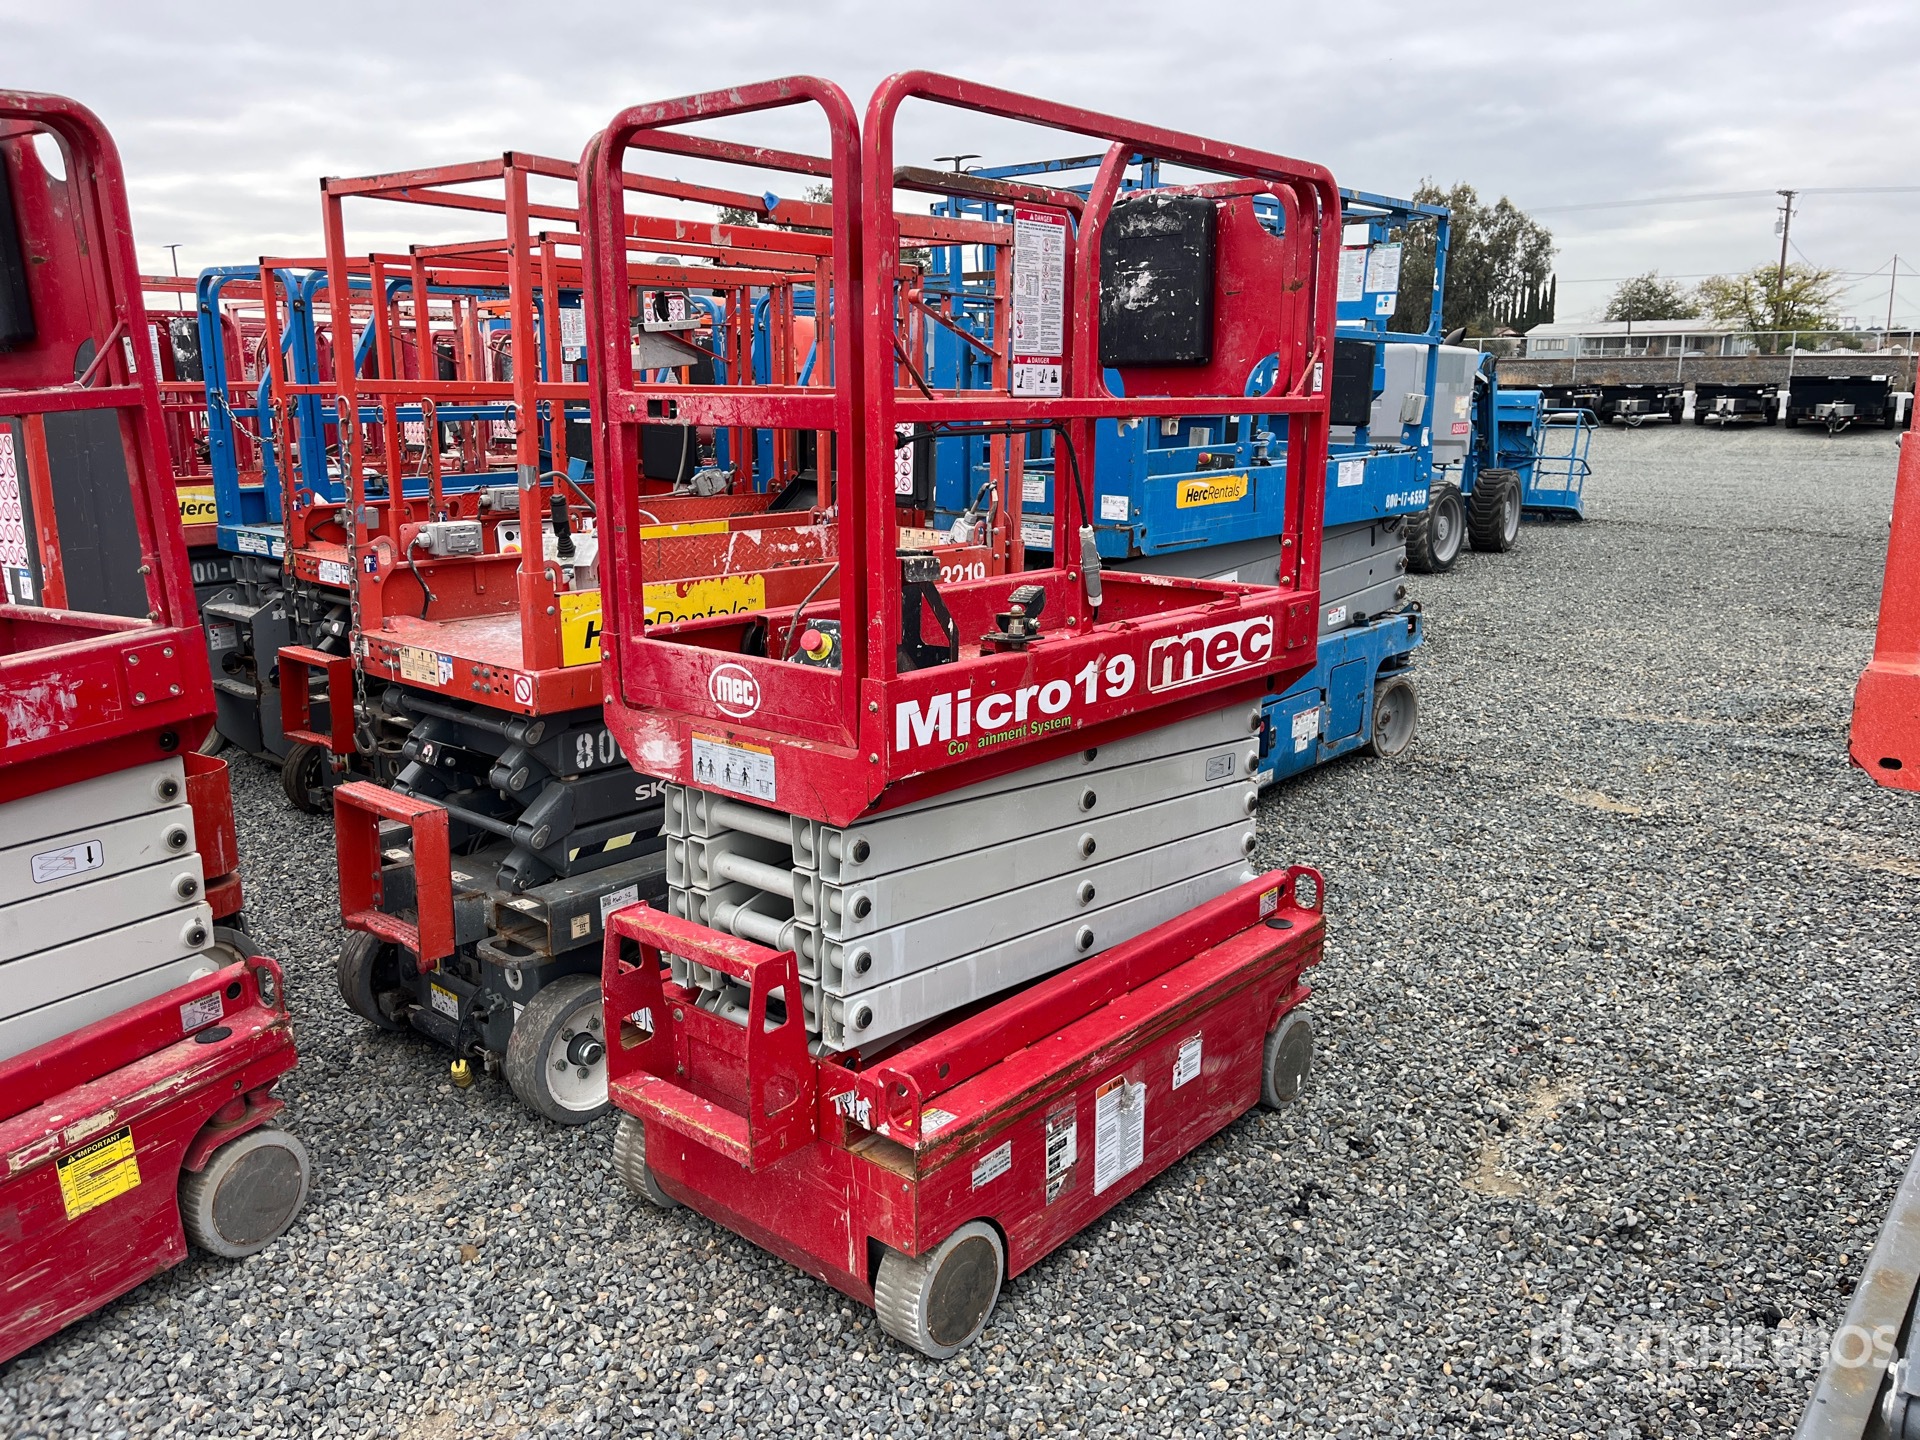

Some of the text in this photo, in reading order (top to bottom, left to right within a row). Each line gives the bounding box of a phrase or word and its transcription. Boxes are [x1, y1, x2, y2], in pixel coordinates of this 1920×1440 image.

[1034, 213, 1053, 224] DANGER
[1031, 356, 1050, 364] DANGER
[1185, 482, 1240, 503] HercRentals
[940, 561, 986, 583] 3219
[1150, 622, 1272, 688] mec
[716, 675, 754, 707] mec
[1030, 715, 1072, 737] System
